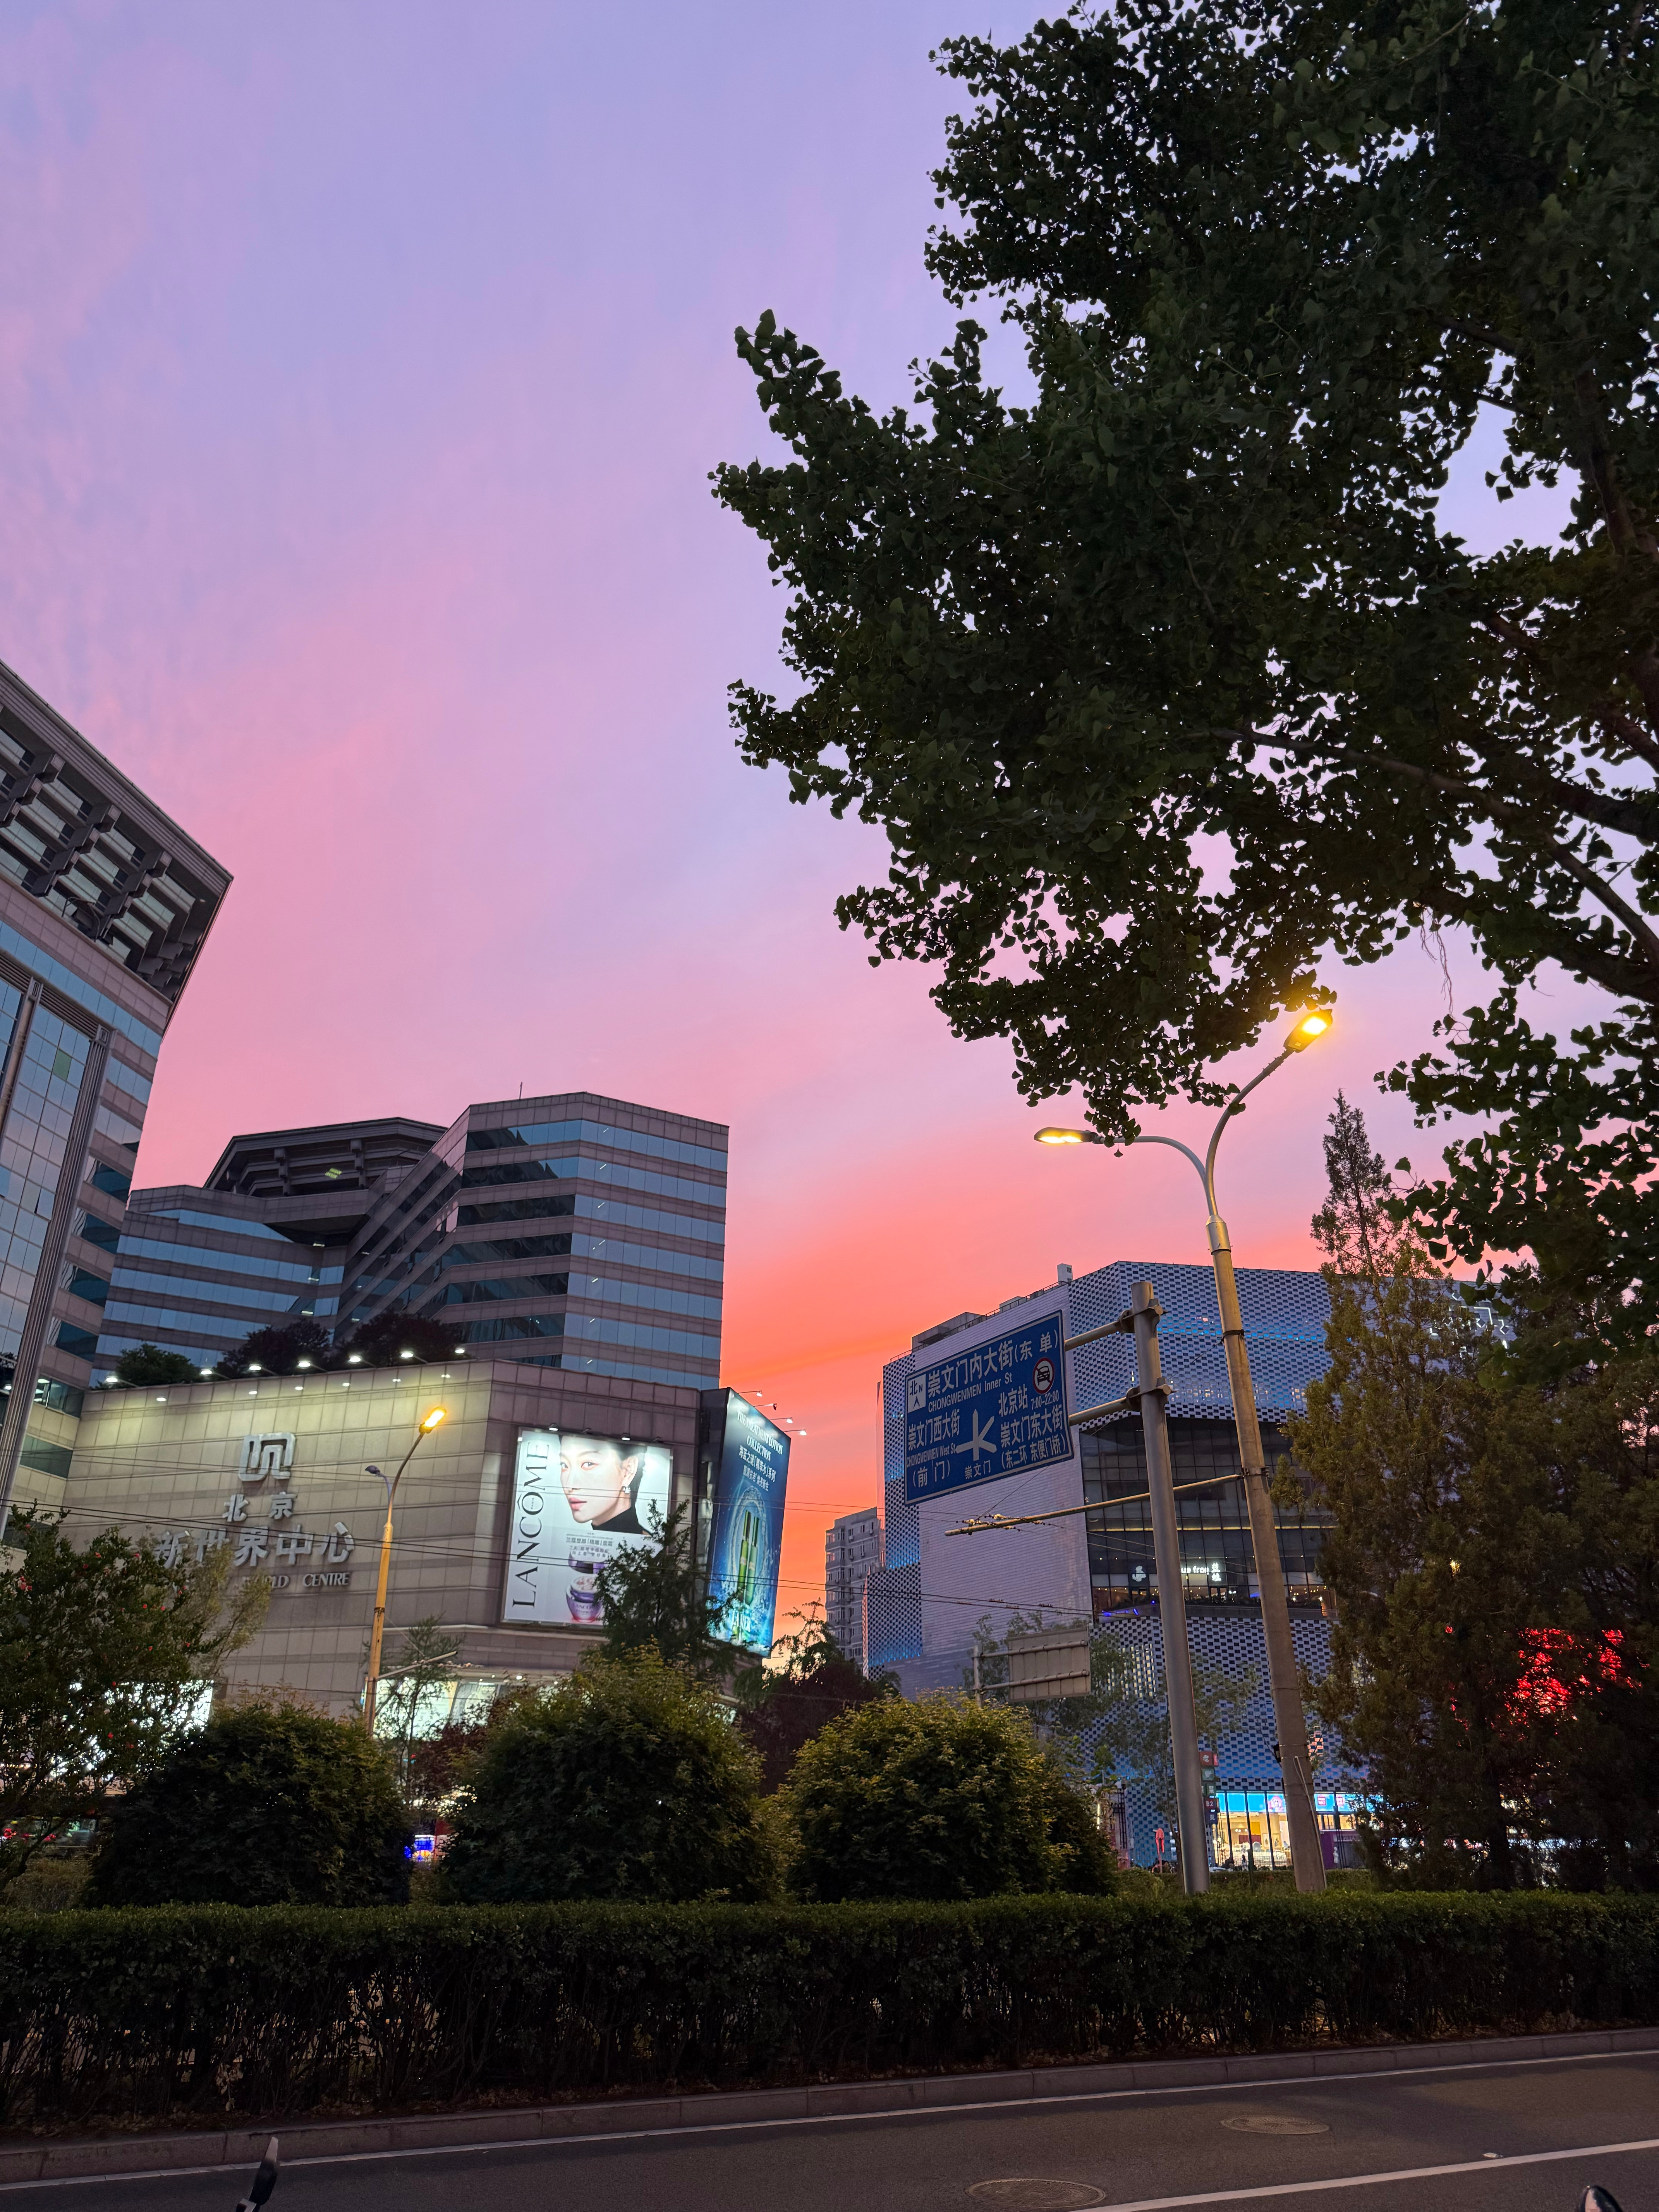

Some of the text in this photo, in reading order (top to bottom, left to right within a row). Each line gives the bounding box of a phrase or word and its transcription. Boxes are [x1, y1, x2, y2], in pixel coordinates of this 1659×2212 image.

[910, 1380, 918, 1396] 北
[919, 1384, 923, 1393] N
[928, 1372, 1012, 1413] CHONGWENMEN Inner St
[998, 1383, 1028, 1417] 北京站
[1031, 1390, 1059, 1410] 7:00-22:00
[737, 1410, 746, 1425] THE
[768, 1435, 783, 1455] LOTION
[908, 1408, 960, 1451] 崇文门西大街
[1001, 1404, 1063, 1448] 崇文门东大街
[747, 1435, 771, 1462] COLLECTION
[907, 1443, 956, 1468] CHONGWENMEN West St
[913, 1460, 950, 1488] （前门）
[965, 1460, 991, 1480] 崇文门
[222, 1491, 297, 1522] 北京
[512, 1442, 549, 1609] LANCÔME
[155, 1522, 355, 1569] 新世界中心
[302, 1572, 351, 1588] CENTRE
